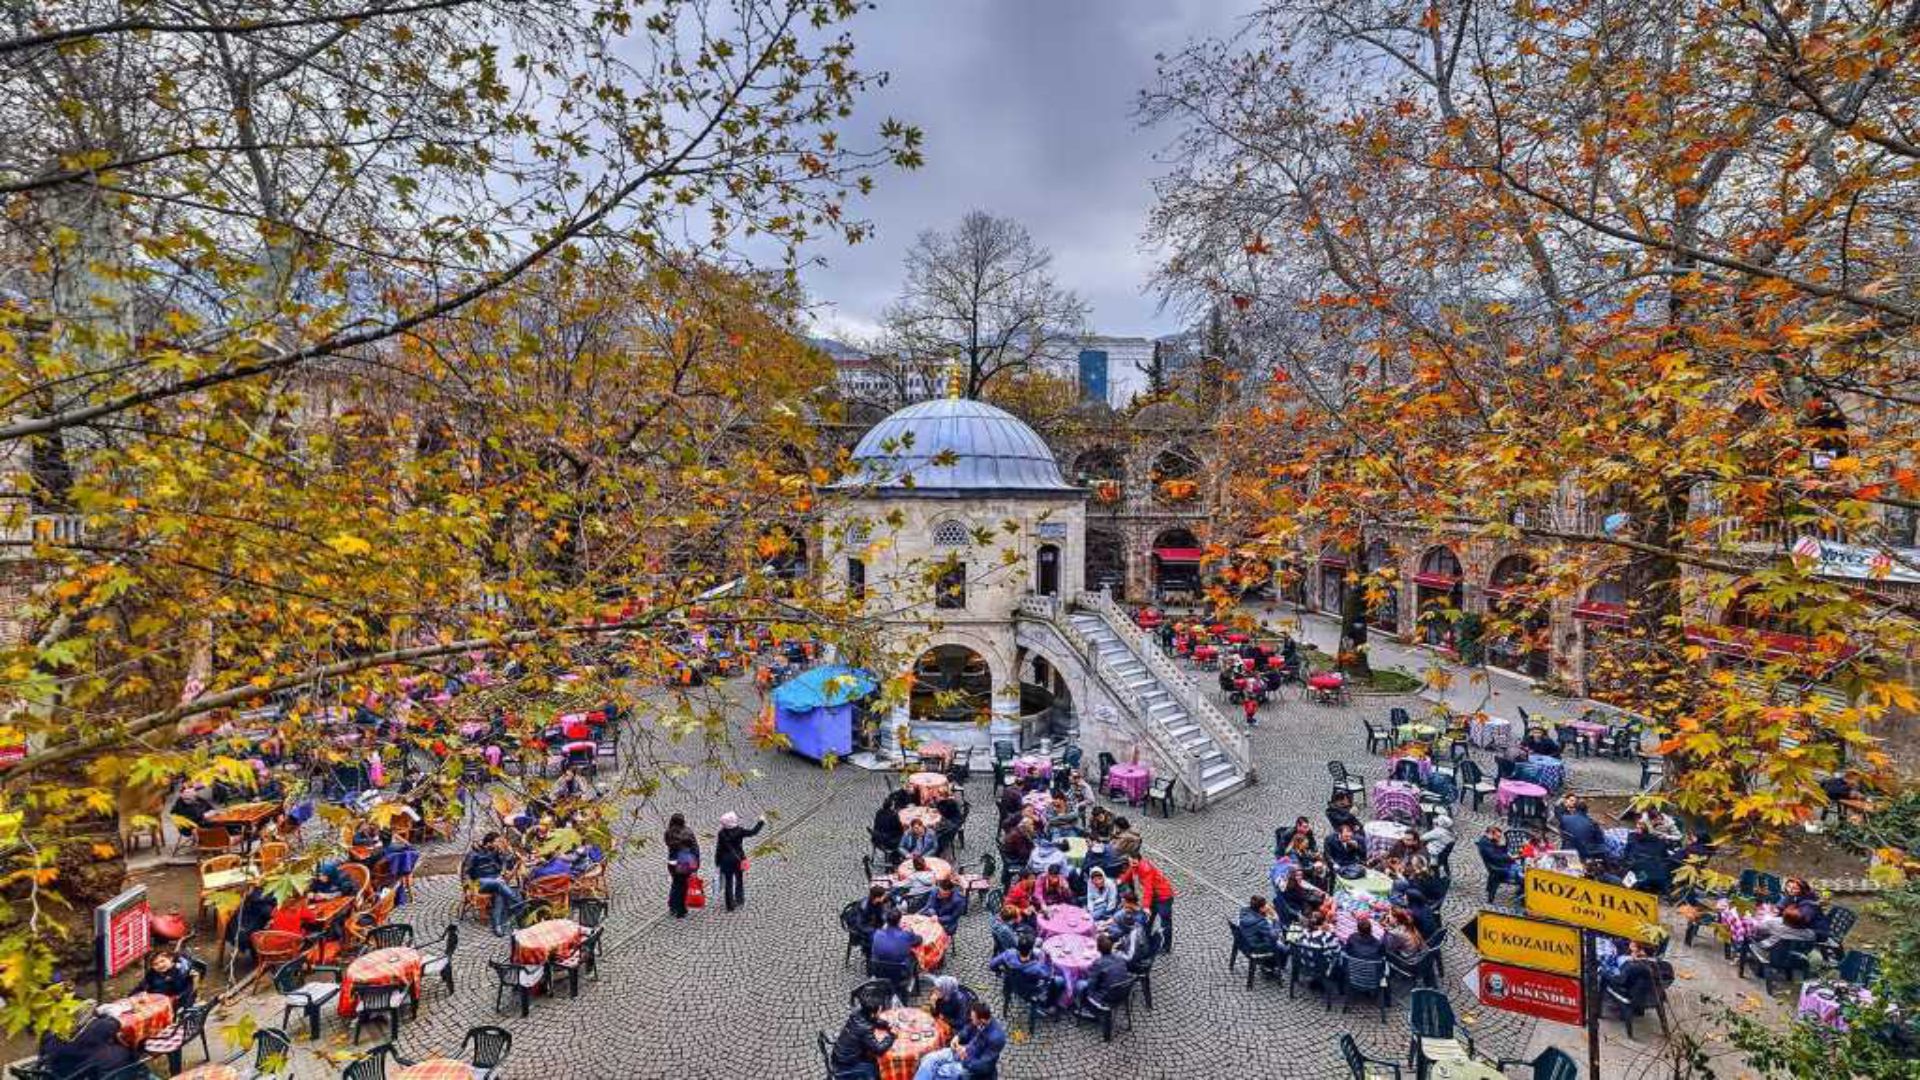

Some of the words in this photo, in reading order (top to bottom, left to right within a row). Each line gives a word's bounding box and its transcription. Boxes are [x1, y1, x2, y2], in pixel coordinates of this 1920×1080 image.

[1532, 877, 1593, 905] KOZA
[1600, 893, 1650, 917] HAN
[1501, 931, 1575, 955] KOZAHAN
